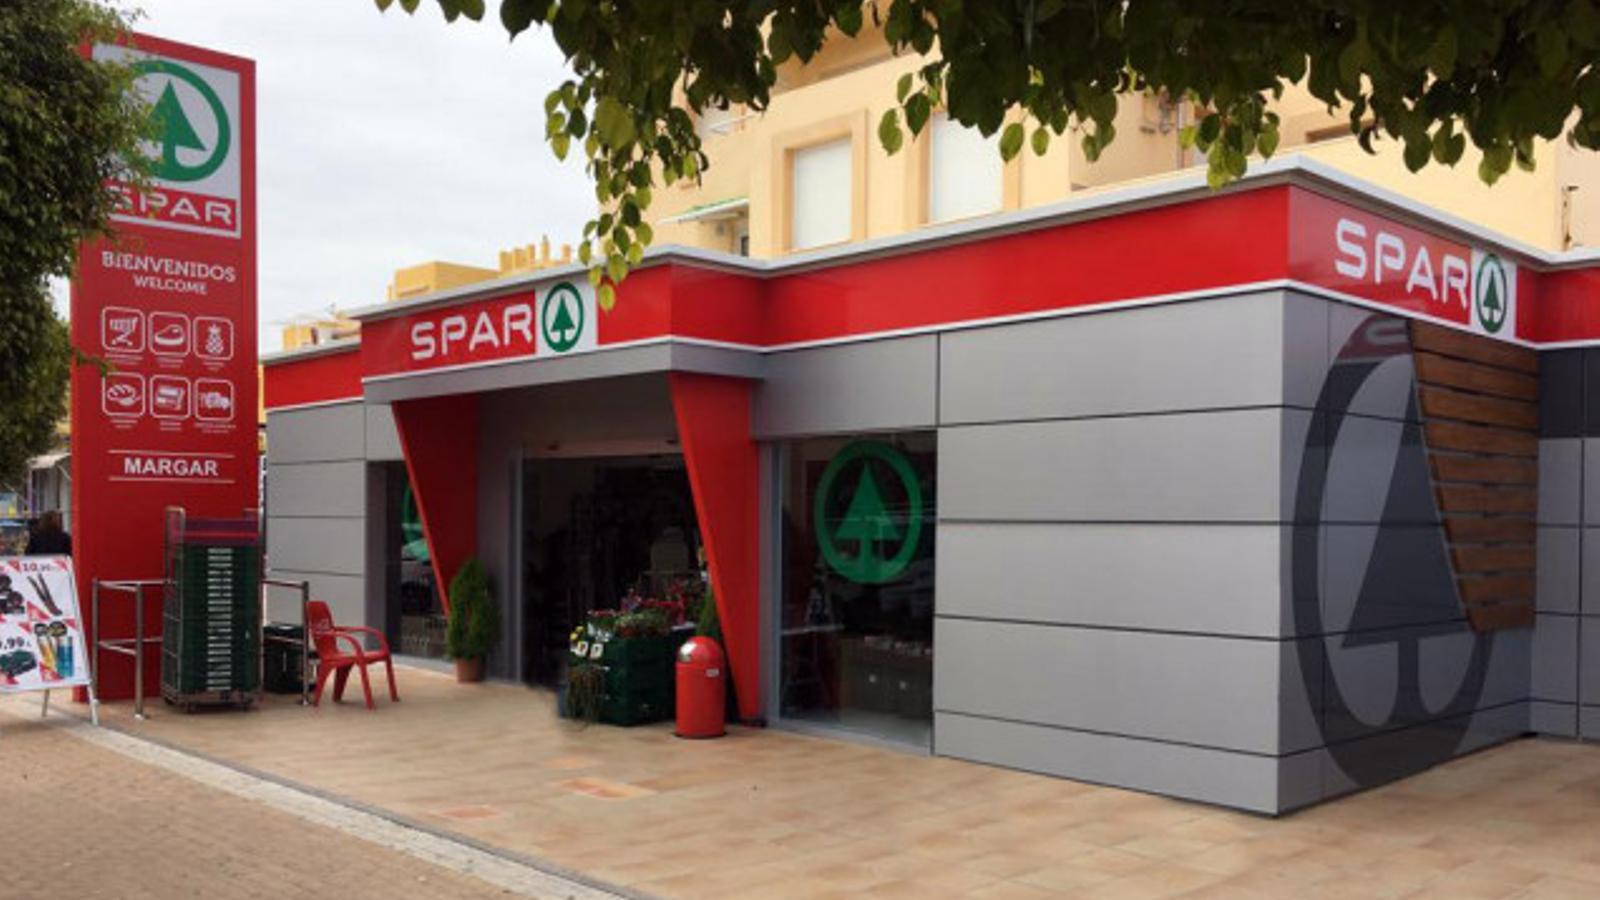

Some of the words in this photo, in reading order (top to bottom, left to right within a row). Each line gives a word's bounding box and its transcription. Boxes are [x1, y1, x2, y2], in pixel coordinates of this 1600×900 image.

[102, 251, 236, 282] BIENVENIDOS
[1335, 218, 1467, 310] SPAR
[133, 274, 207, 295] WELCOME
[410, 304, 533, 360] SPAR
[124, 457, 218, 476] MARGAR
